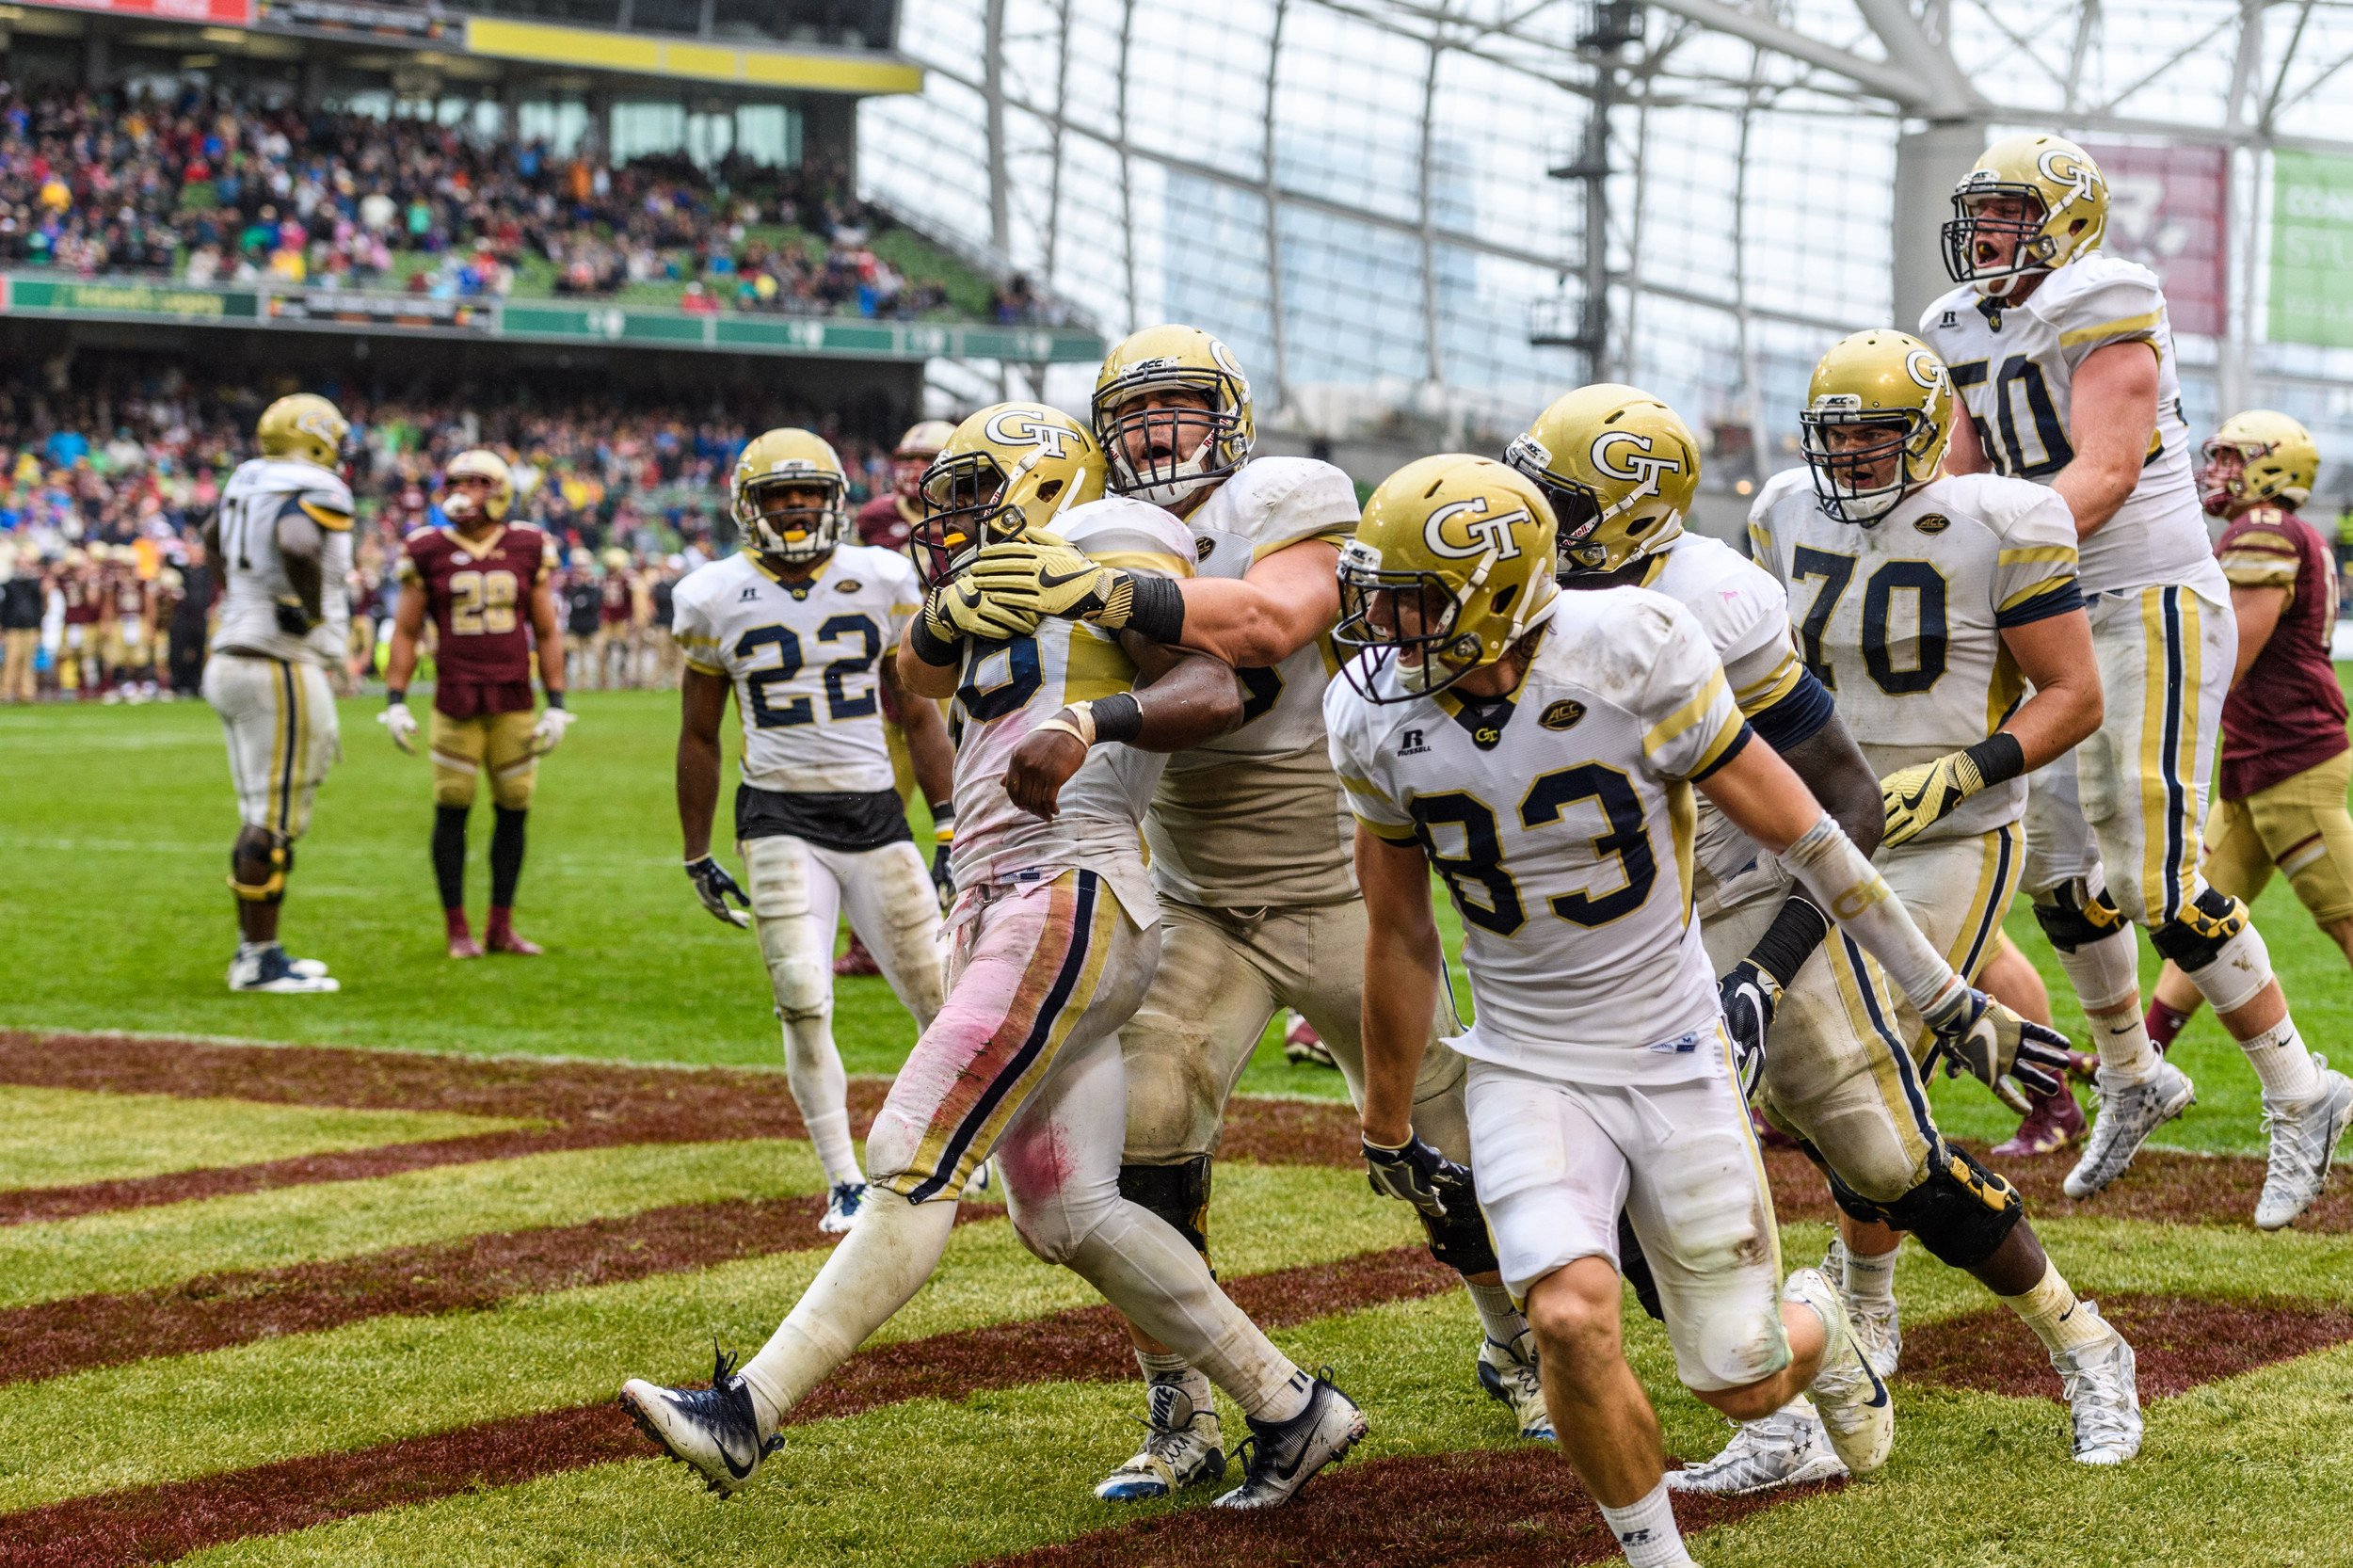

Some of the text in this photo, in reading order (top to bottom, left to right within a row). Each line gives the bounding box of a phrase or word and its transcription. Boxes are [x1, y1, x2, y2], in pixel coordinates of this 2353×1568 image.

[1135, 360, 1163, 370] ACC
[984, 410, 1081, 460] GT
[1946, 354, 2077, 479] 50
[1591, 431, 1680, 497] GT
[1423, 497, 1531, 561] GT
[1920, 518, 1945, 528] ACC
[2249, 508, 2281, 525] 13
[448, 569, 519, 636] 28
[1791, 543, 1950, 696] 70
[735, 614, 882, 729] 22
[1475, 728, 1498, 743] GT
[1548, 703, 1581, 723] ACC
[1398, 745, 1432, 757] RUSSELL
[1402, 728, 1424, 749] R
[1409, 759, 1659, 938] 83
[1152, 1386, 1175, 1427] NIKE
